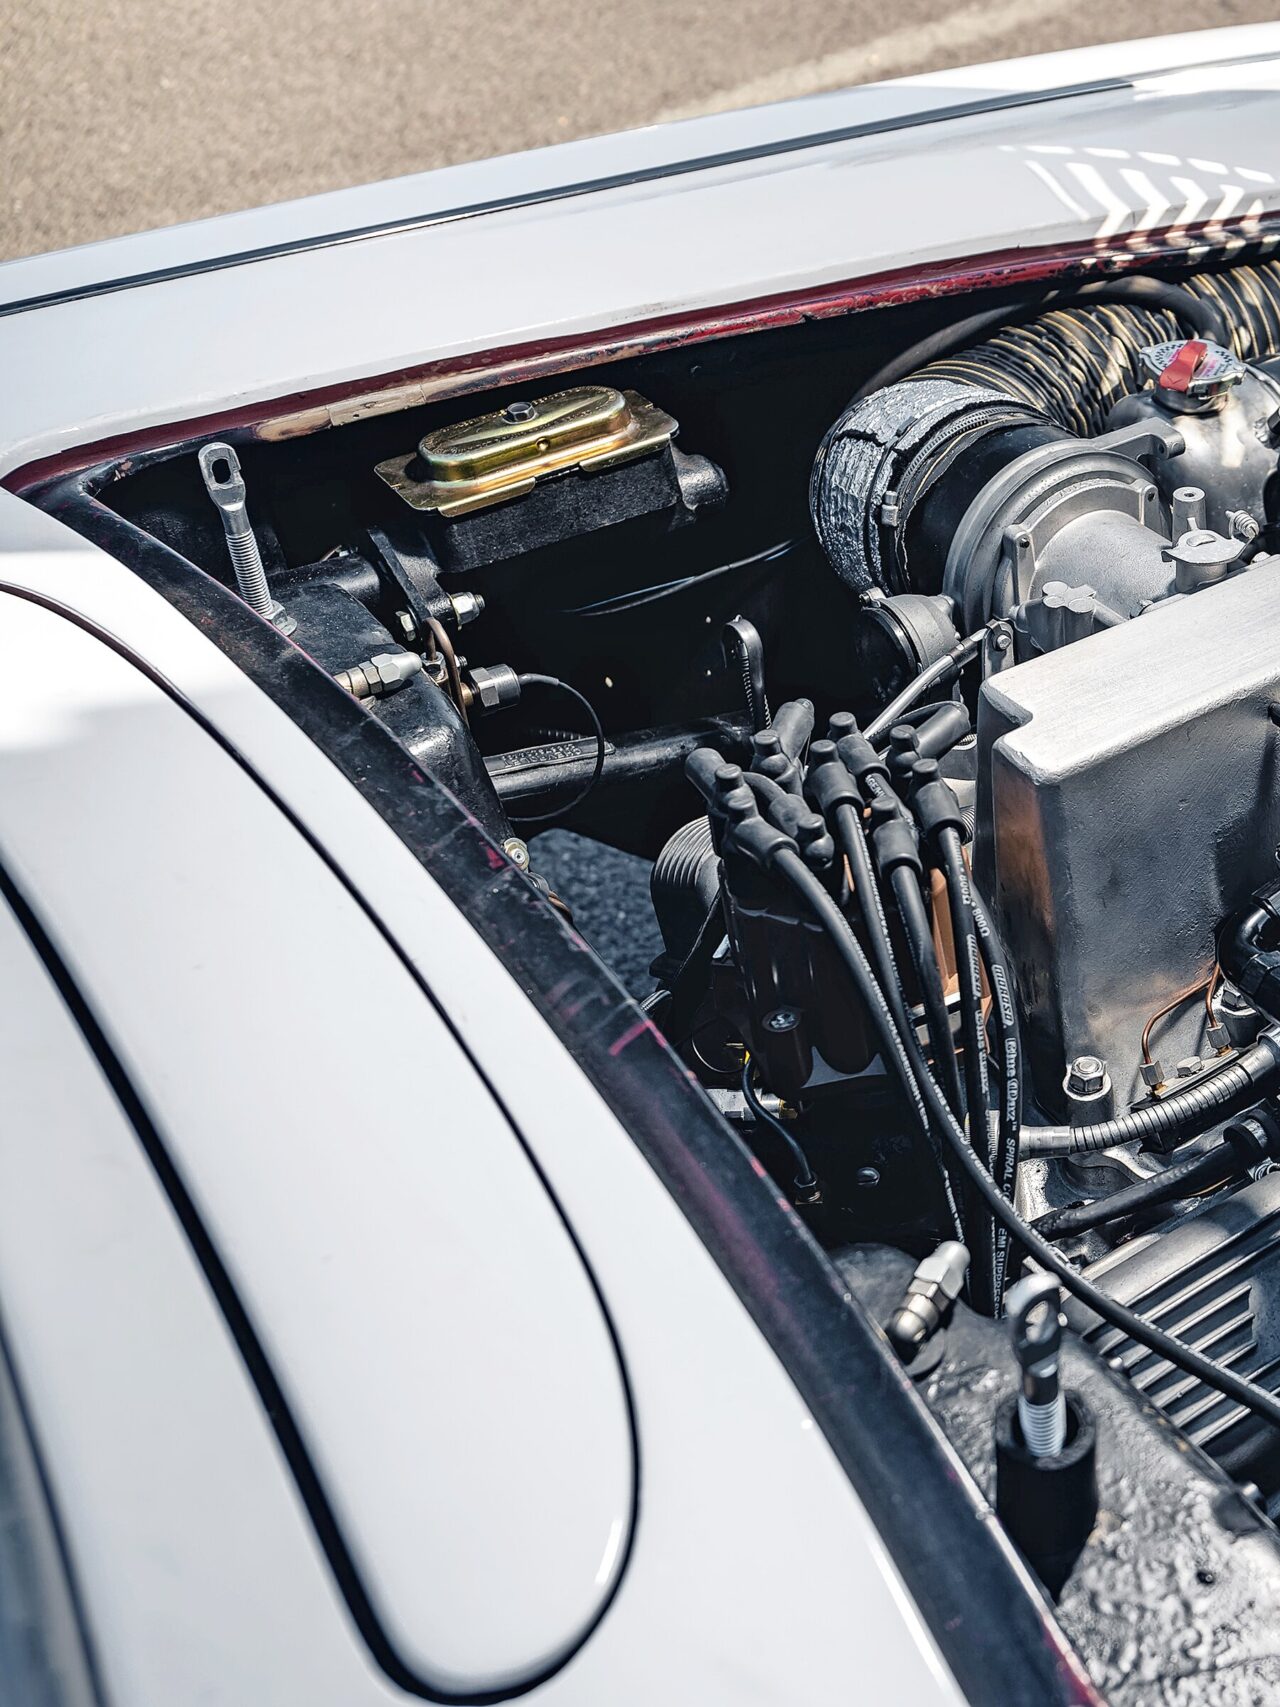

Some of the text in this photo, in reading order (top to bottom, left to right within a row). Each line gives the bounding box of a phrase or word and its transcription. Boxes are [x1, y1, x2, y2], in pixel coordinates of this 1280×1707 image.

[971, 907, 991, 938] 800Ω
[1003, 1036, 1018, 1077] Blue
[1004, 1138, 1016, 1180] SPIRAL
